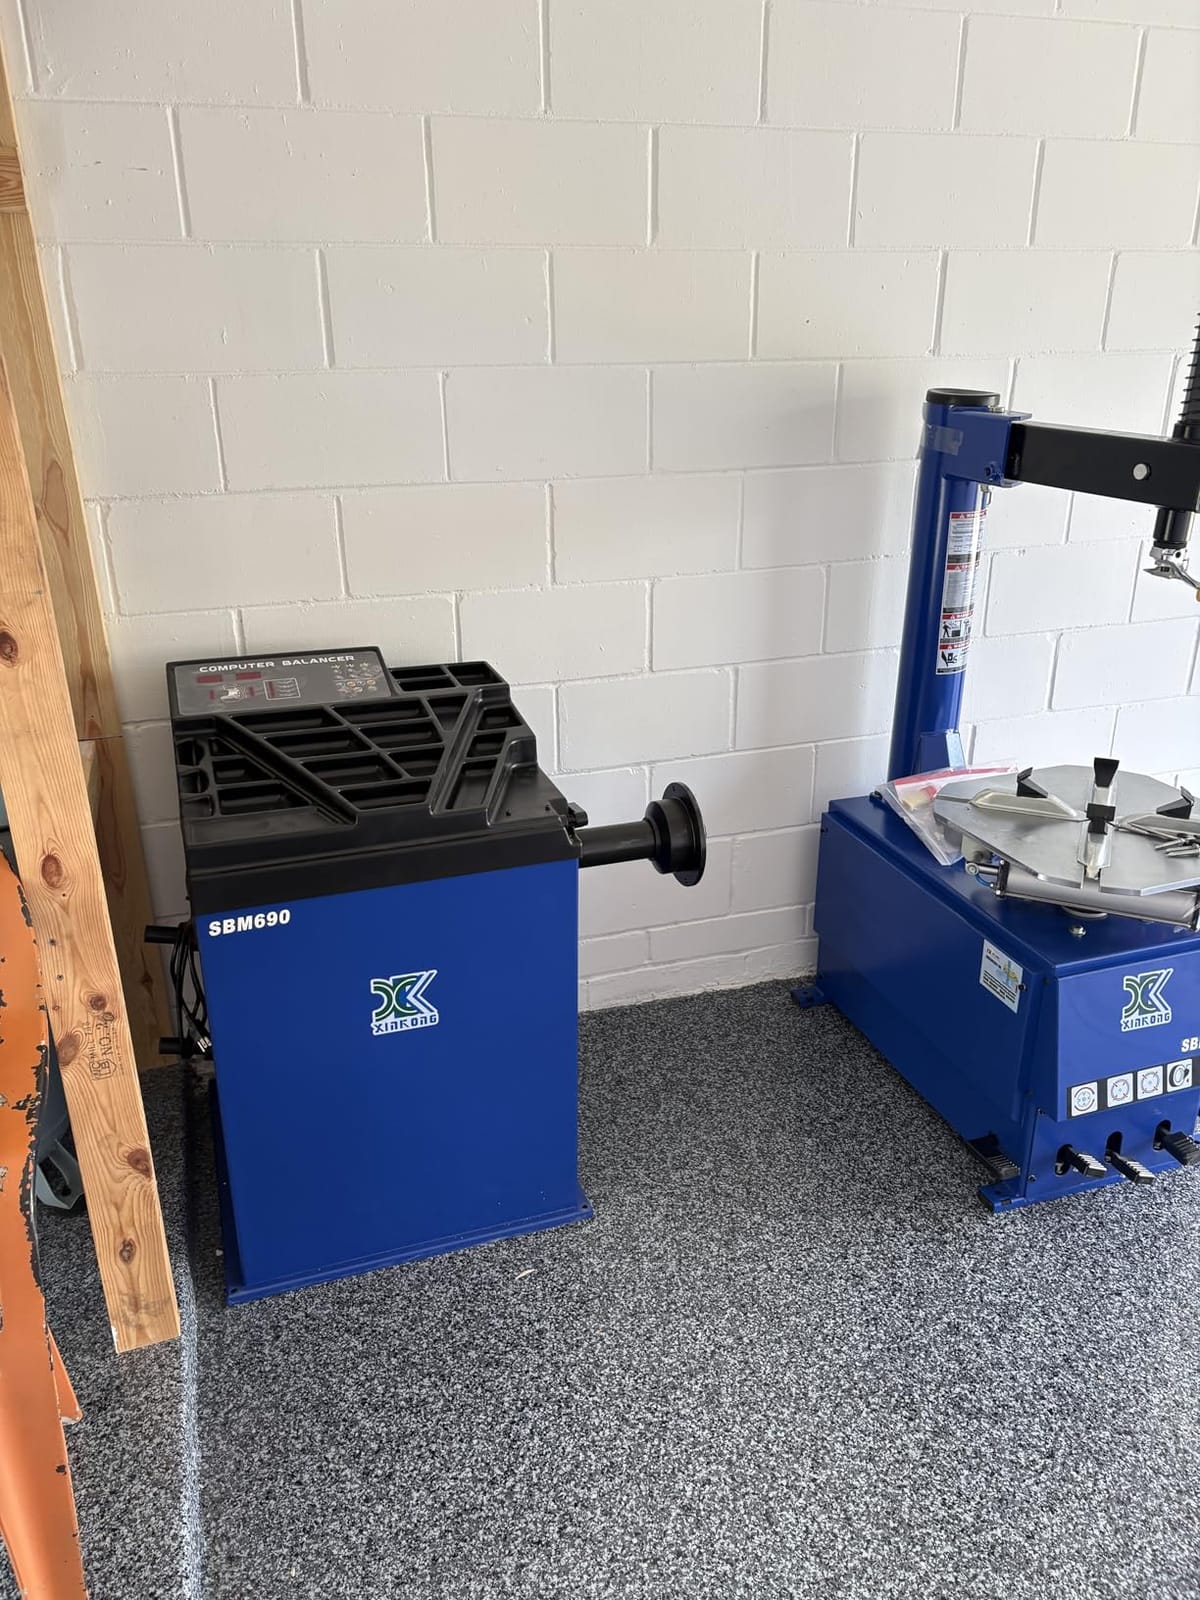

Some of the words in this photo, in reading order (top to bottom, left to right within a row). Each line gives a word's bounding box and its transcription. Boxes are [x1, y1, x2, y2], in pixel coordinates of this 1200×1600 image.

[199, 661, 275, 673] COMPUTER
[282, 655, 355, 667] BALANCER
[208, 909, 291, 937] SBM690
[373, 1014, 438, 1034] XINKONG
[1122, 1012, 1170, 1030] XINKONG
[1181, 1037, 1200, 1053] SB
